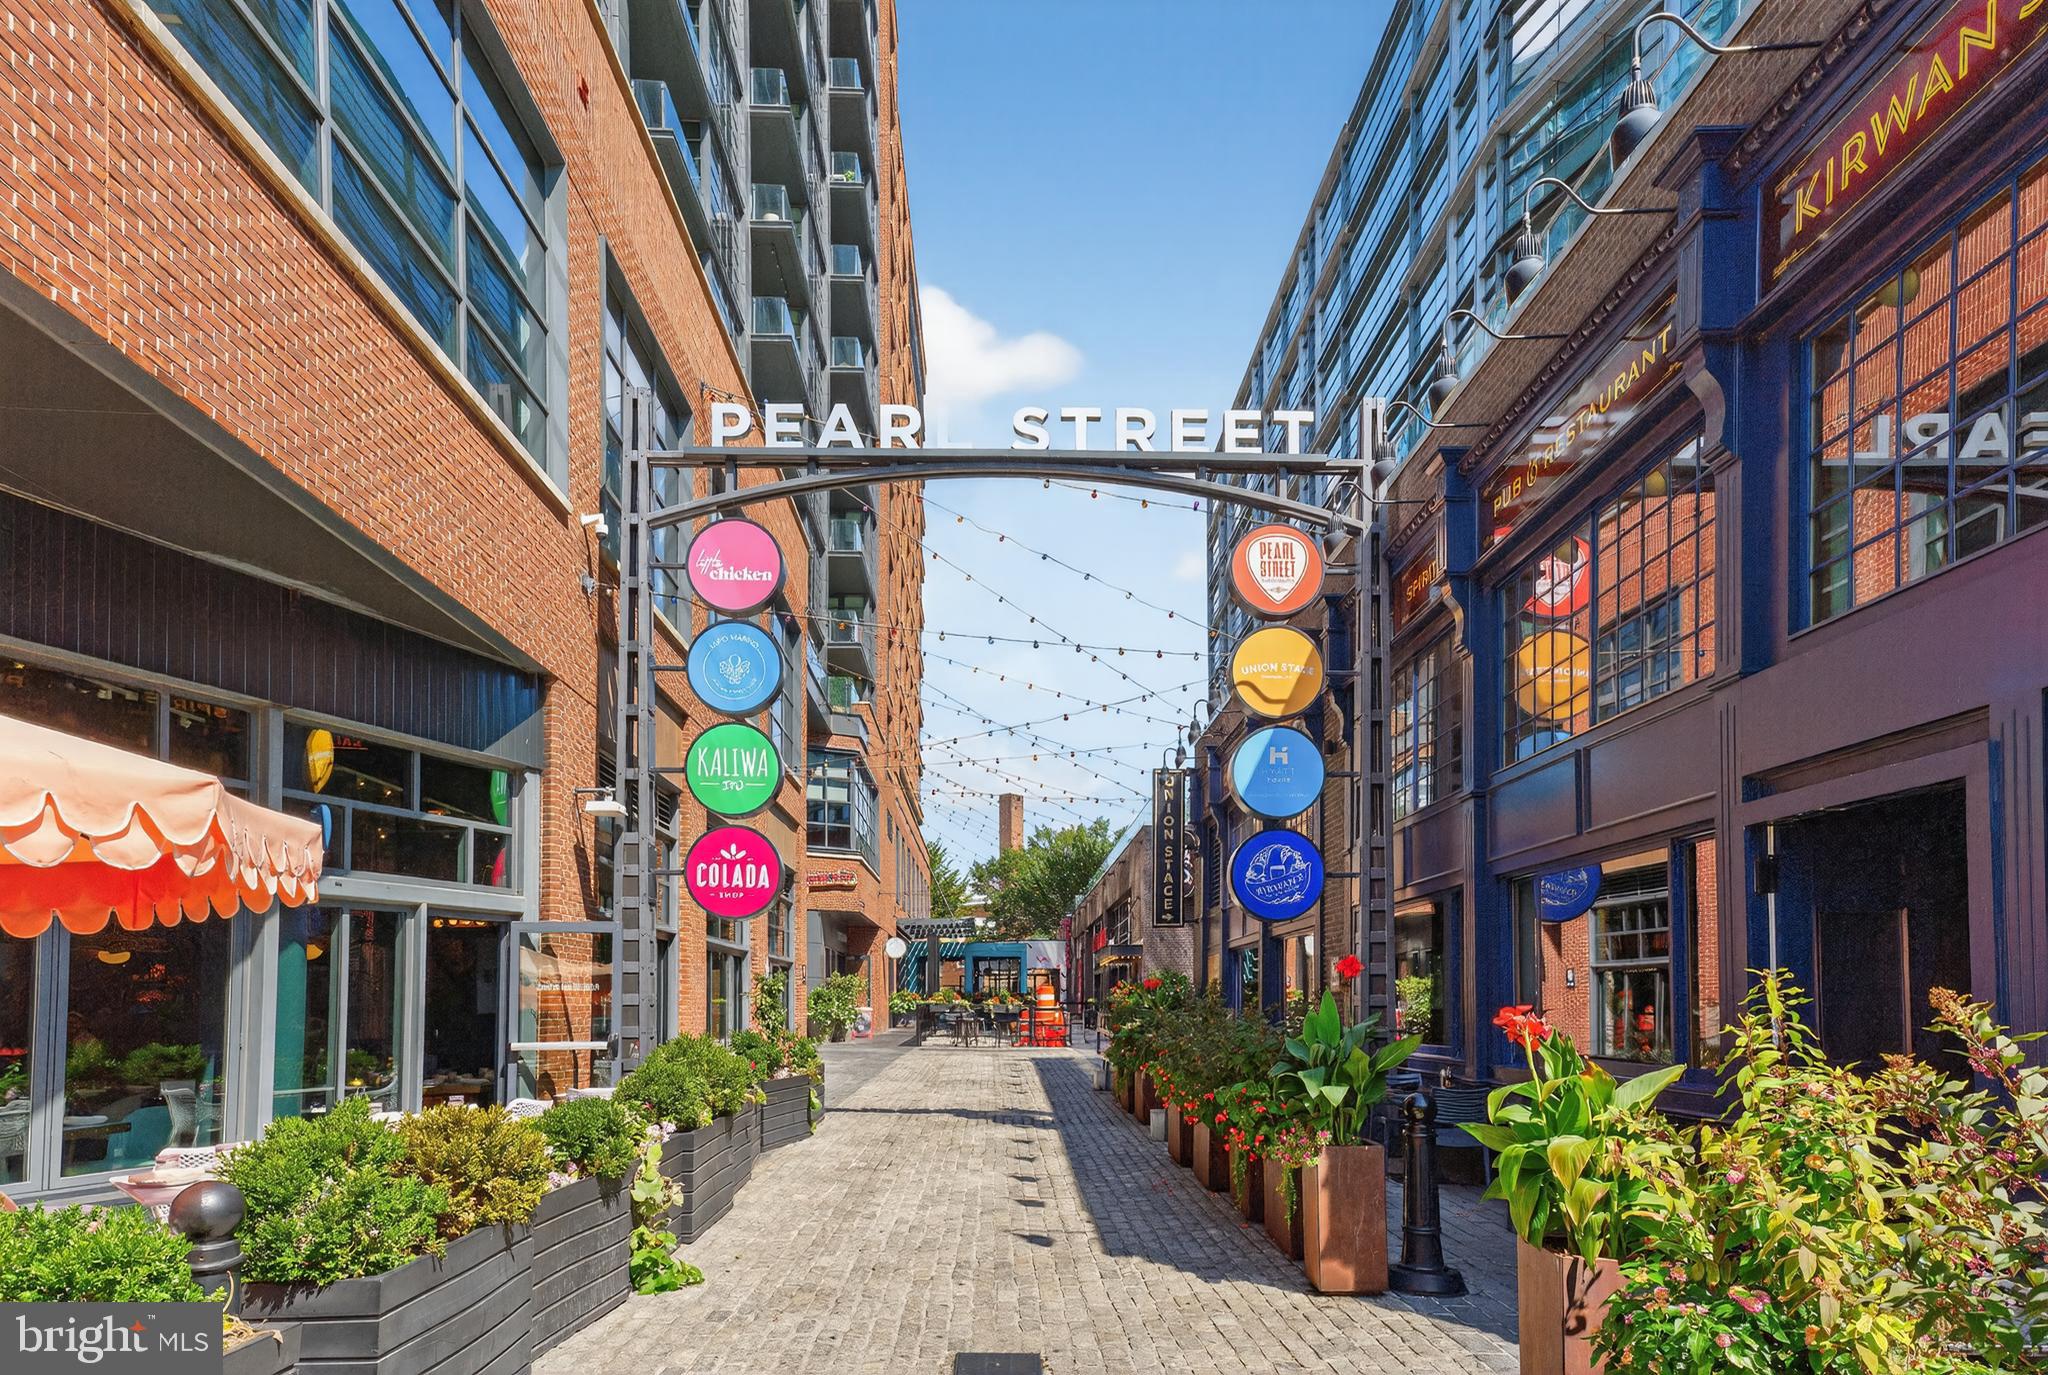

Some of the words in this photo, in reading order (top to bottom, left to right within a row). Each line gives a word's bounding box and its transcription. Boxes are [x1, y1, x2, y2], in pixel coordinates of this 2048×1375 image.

[711, 402, 973, 449] PEARL
[1011, 406, 1315, 455] STREET
[1493, 477, 1522, 517] PUB
[1544, 320, 1672, 469] RESTAURANT
[1259, 542, 1296, 560] PEARL
[709, 566, 772, 581] chicken
[1260, 561, 1296, 578] STREET
[1241, 662, 1278, 675] UNION
[697, 747, 768, 777] KALIWA
[696, 862, 770, 889] COLADA
[1163, 846, 1174, 910] STAGE
